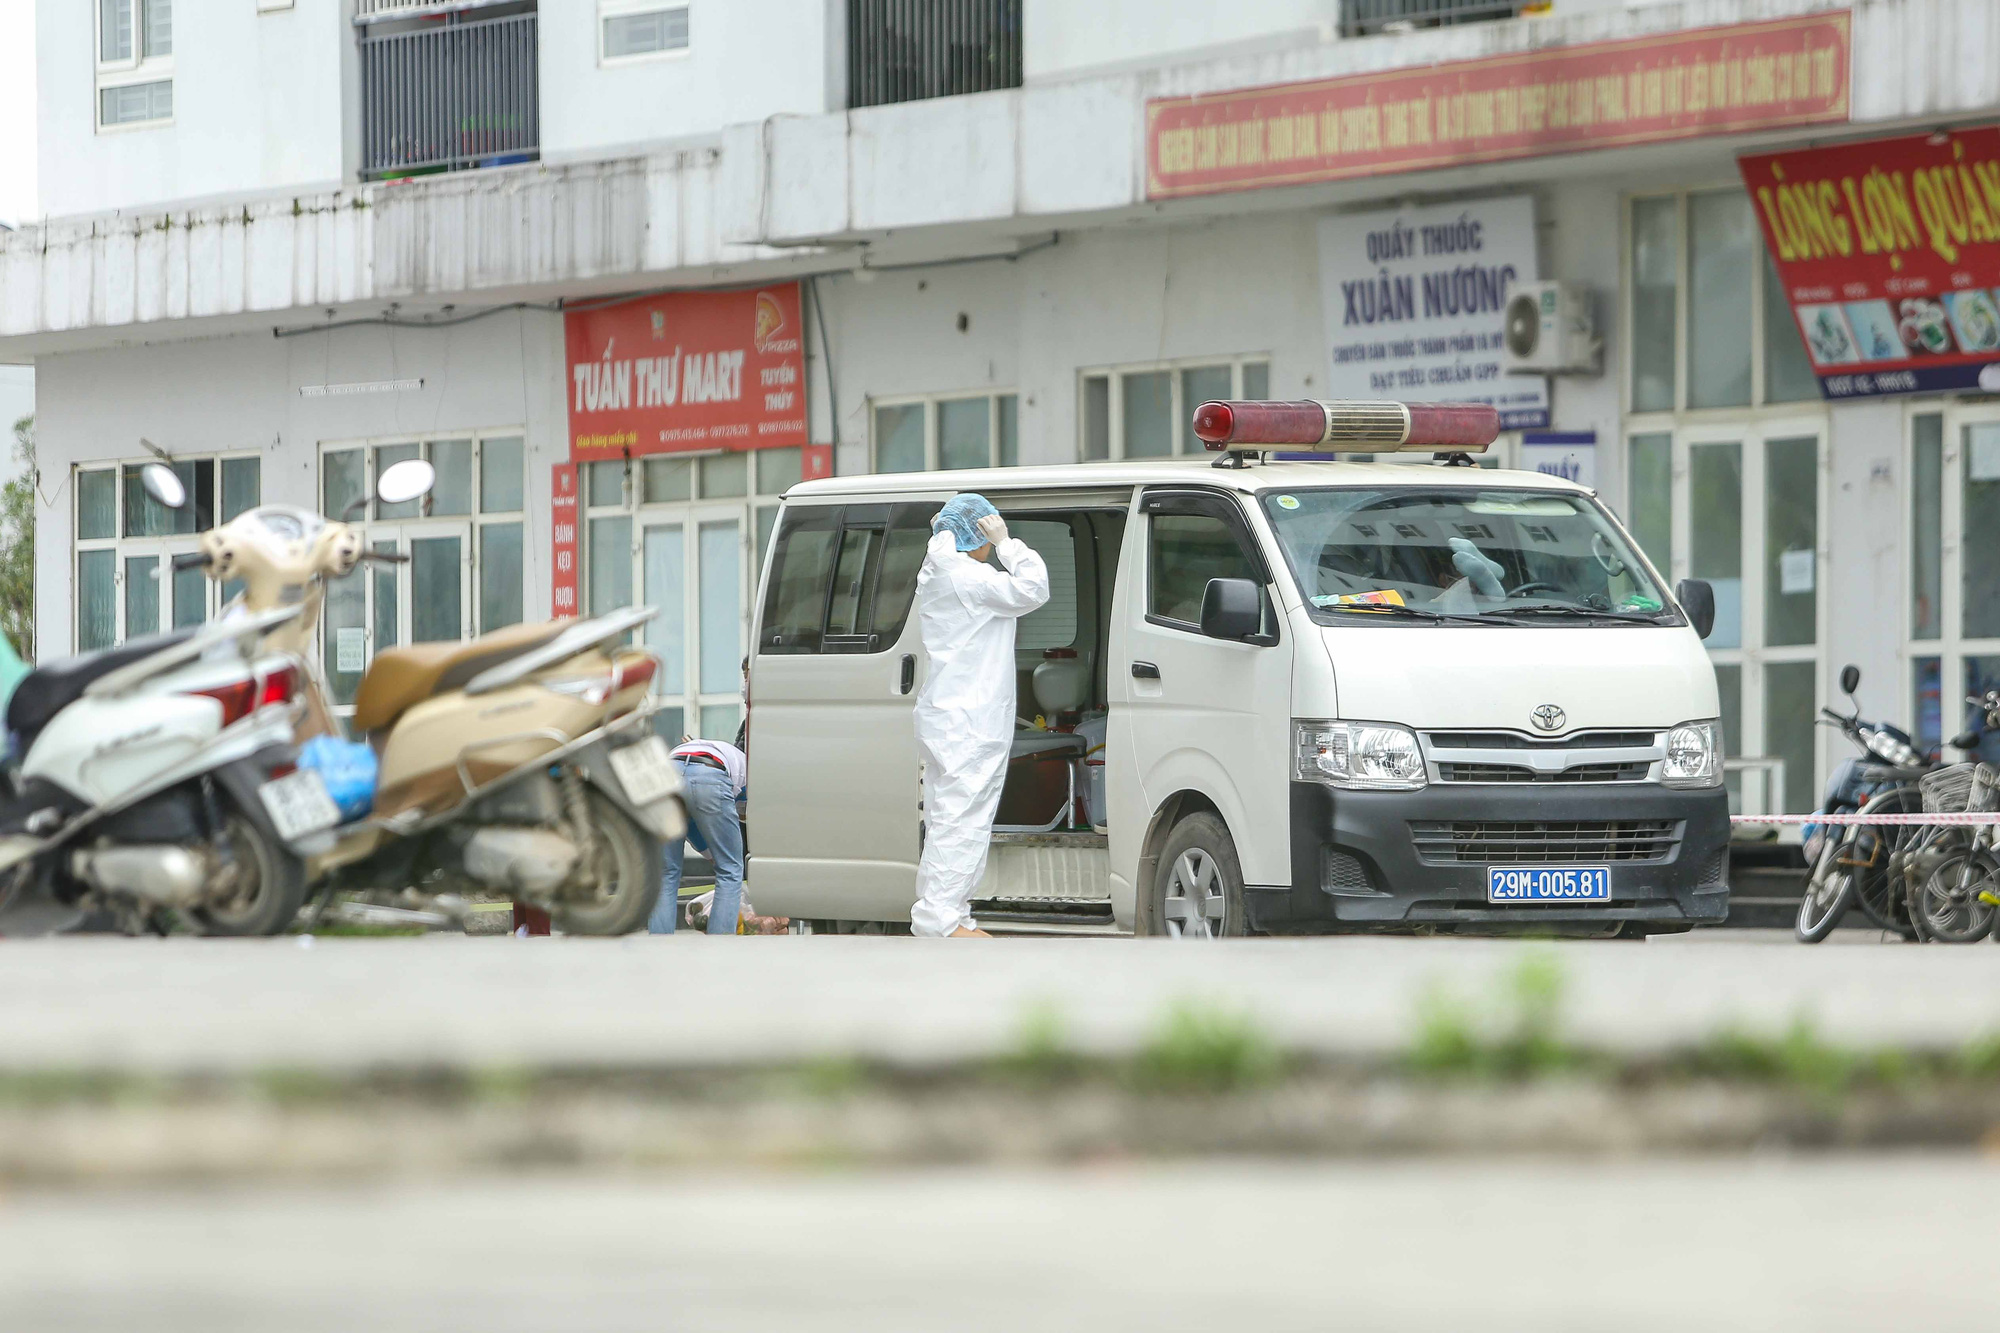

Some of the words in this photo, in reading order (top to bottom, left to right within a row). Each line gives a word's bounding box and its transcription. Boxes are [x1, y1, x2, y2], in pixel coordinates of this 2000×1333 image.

[1420, 210, 1482, 255] THUỐC
[1757, 160, 1851, 262] LÒNG
[1341, 267, 1414, 326] XUÂN
[573, 338, 630, 413] TUẤN
[634, 346, 681, 409] THƯ
[682, 349, 745, 404] MART
[555, 521, 573, 543] BÁNH
[557, 551, 571, 573] KẸO
[1493, 871, 1603, 897] 29M-005.81
